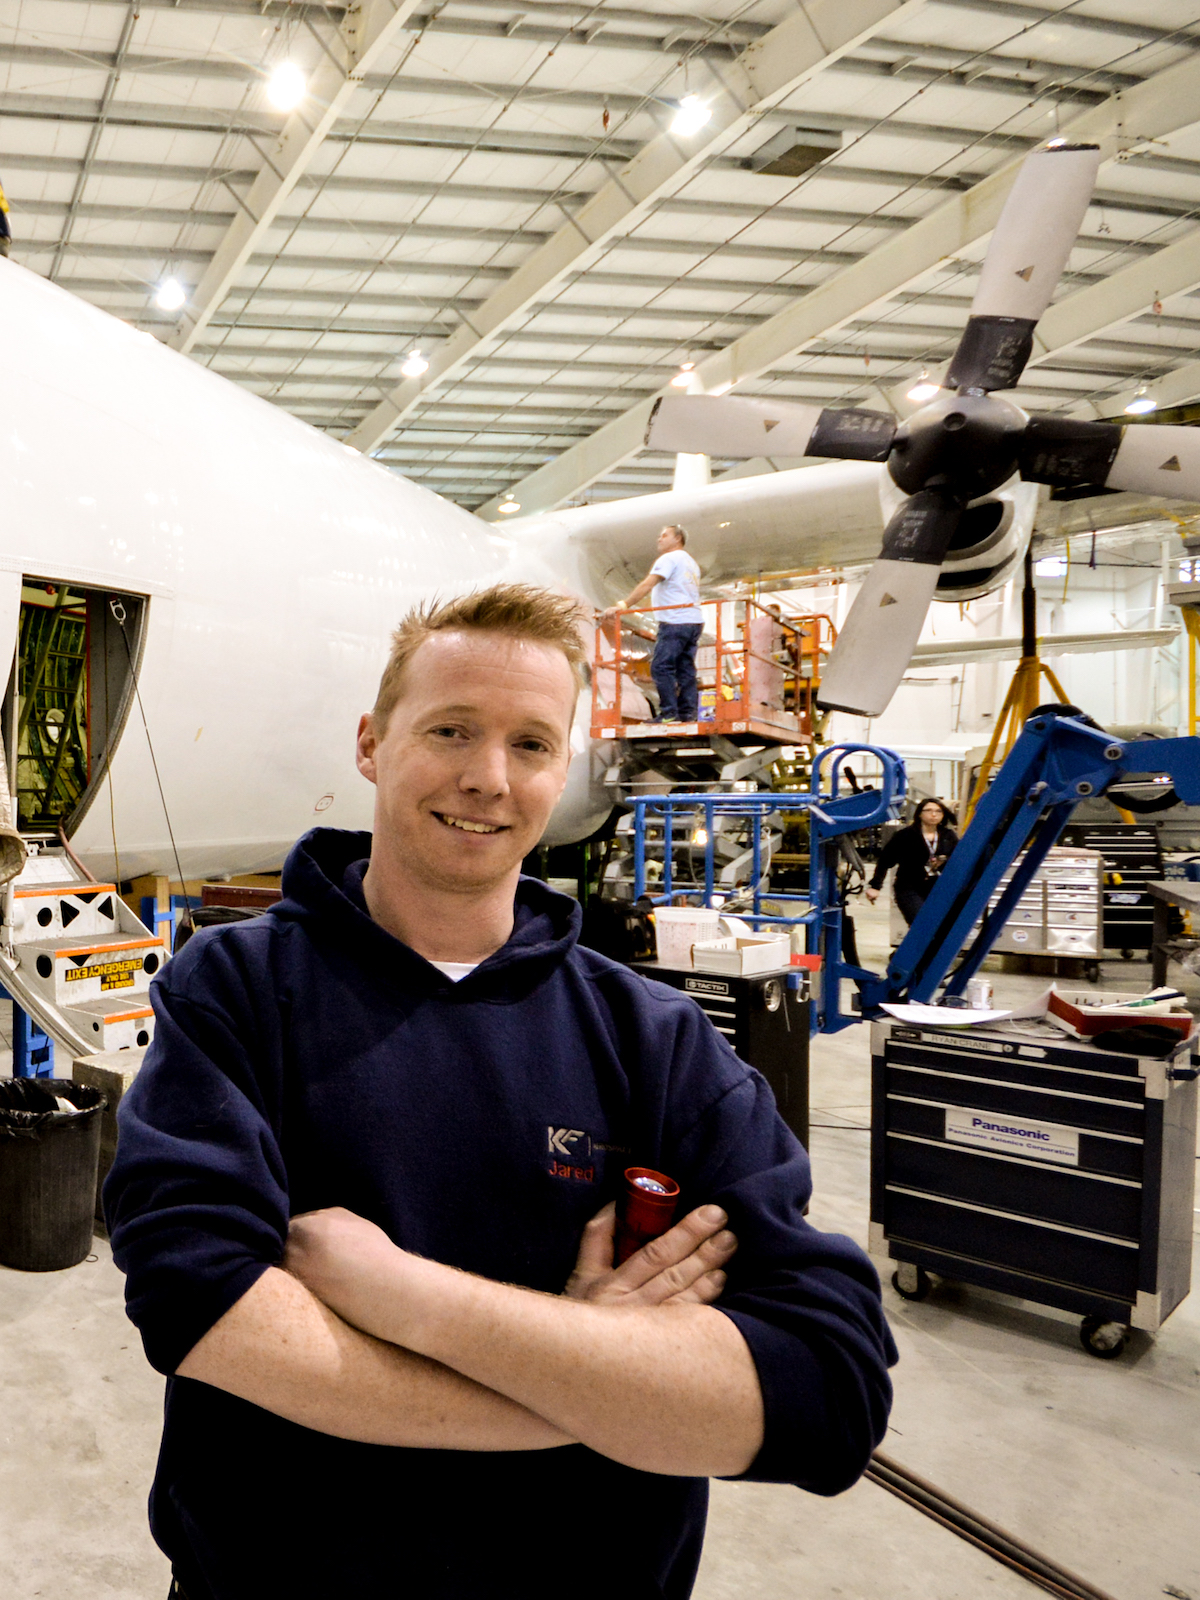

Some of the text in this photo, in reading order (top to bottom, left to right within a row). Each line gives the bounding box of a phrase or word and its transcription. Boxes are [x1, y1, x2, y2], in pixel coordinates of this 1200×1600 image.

[66, 958, 143, 981] EMERGENCY EXIT
[106, 974, 119, 982] ONLY
[101, 983, 110, 991] AIR
[114, 979, 135, 989] GROUND
[697, 982, 725, 991] TACTIX
[931, 1035, 992, 1050] RYAN CRANE
[972, 1117, 1051, 1141] Panasonic
[547, 1126, 585, 1155] KF
[948, 1127, 1076, 1157] Panasonic Avionics Corporation
[549, 1160, 594, 1182] Jared
